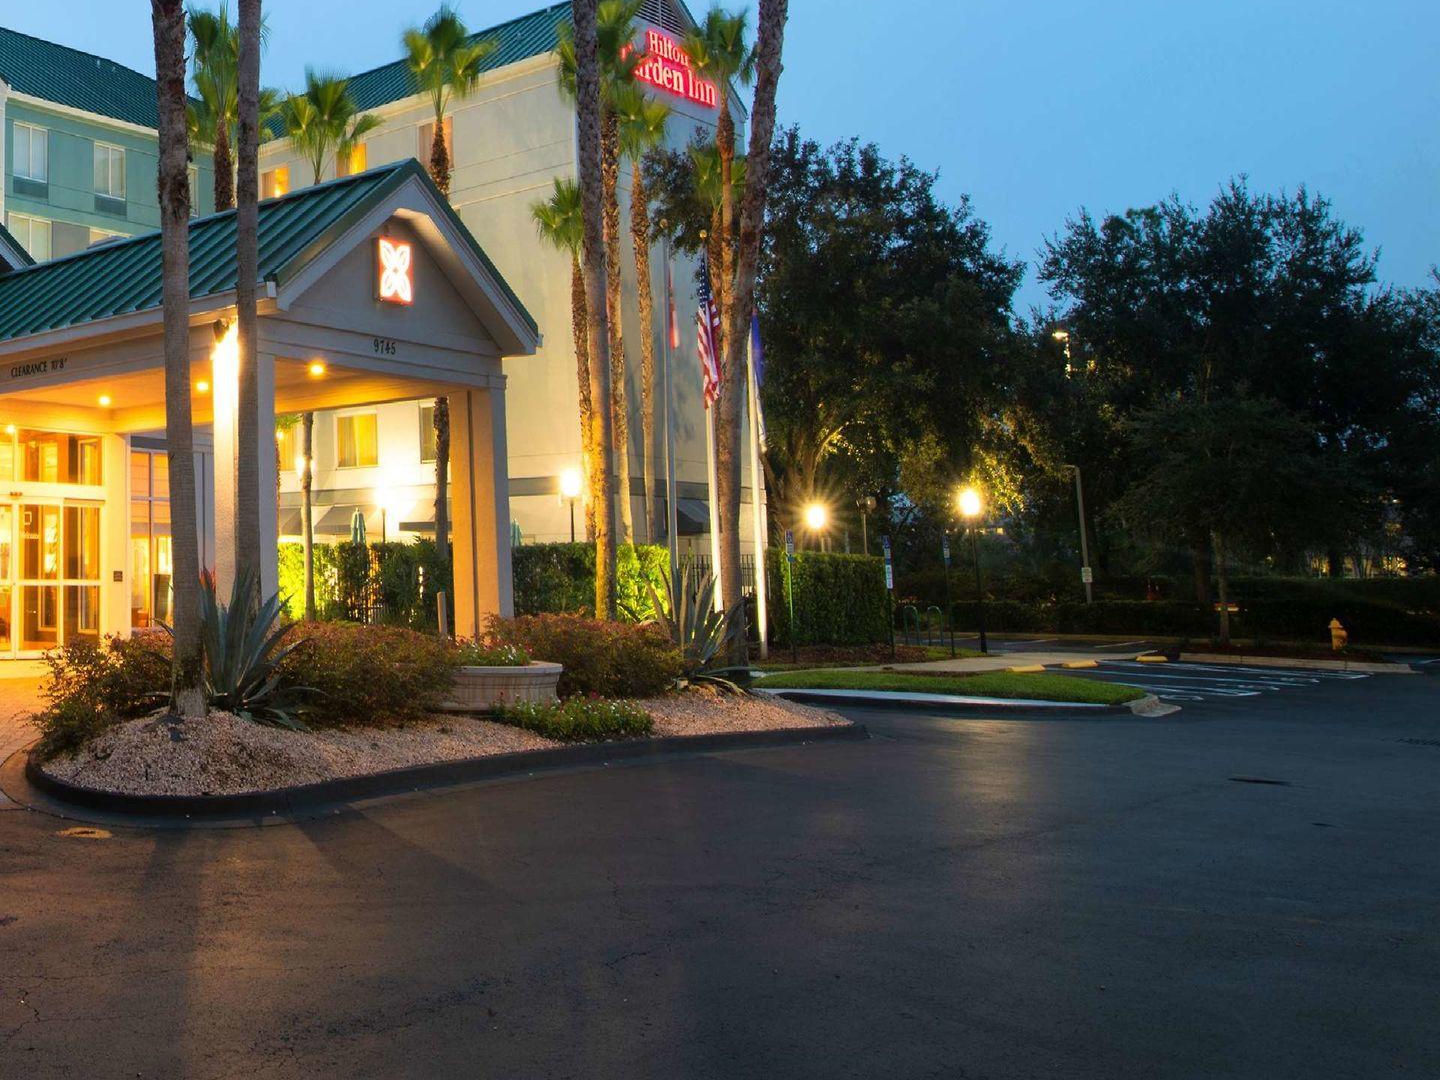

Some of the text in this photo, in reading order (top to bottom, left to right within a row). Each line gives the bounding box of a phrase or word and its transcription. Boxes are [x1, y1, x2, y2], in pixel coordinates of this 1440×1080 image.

[648, 31, 688, 66] Hilton
[620, 43, 717, 106] rden Inn
[11, 361, 48, 378] CLEARANCE
